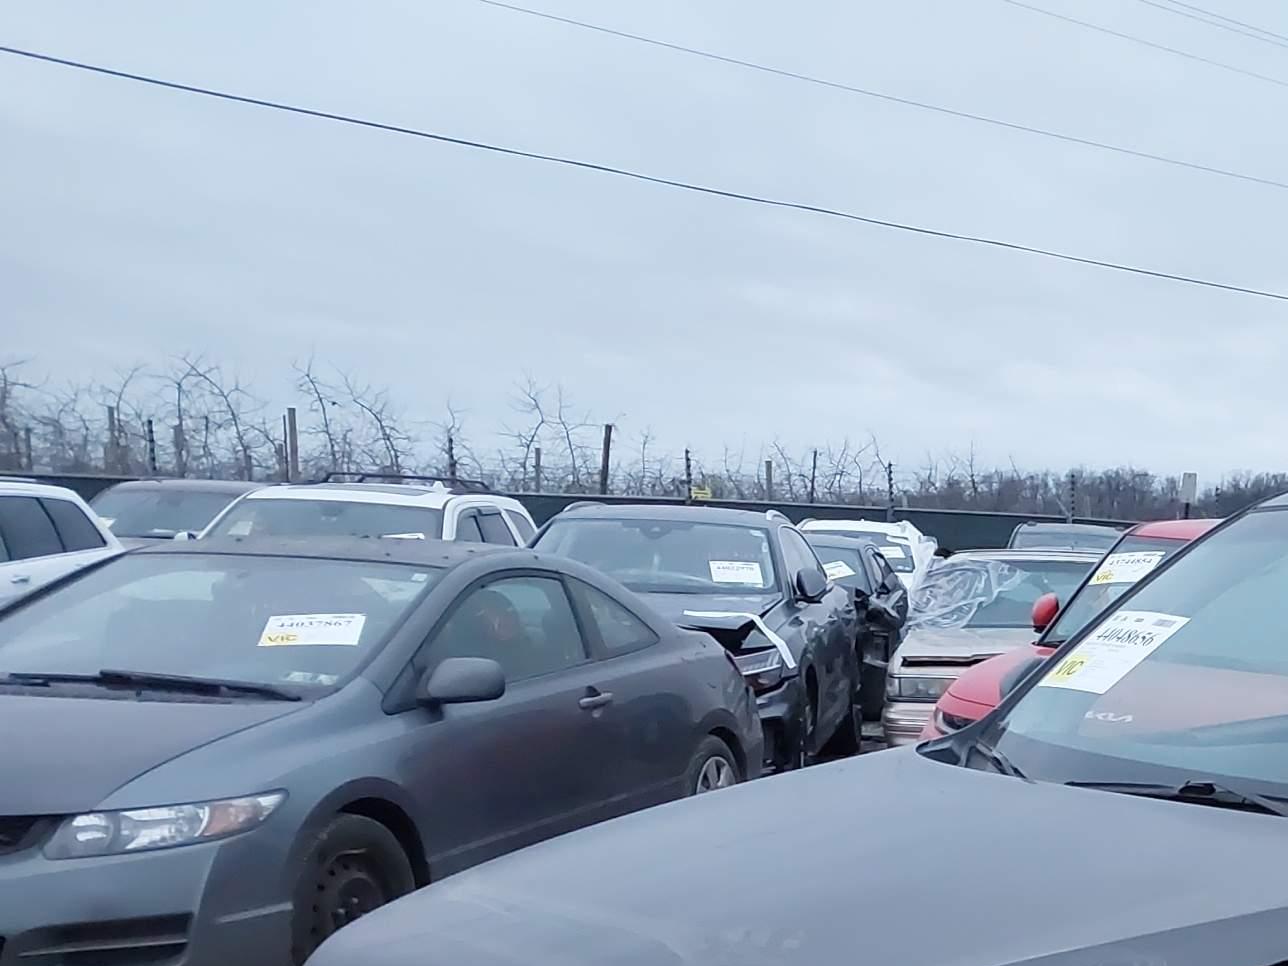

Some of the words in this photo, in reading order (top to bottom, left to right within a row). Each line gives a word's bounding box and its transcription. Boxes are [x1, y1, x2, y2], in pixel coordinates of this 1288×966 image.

[267, 634, 298, 643] VIC
[1097, 628, 1160, 647] 44048656
[1055, 660, 1085, 677] VIC
